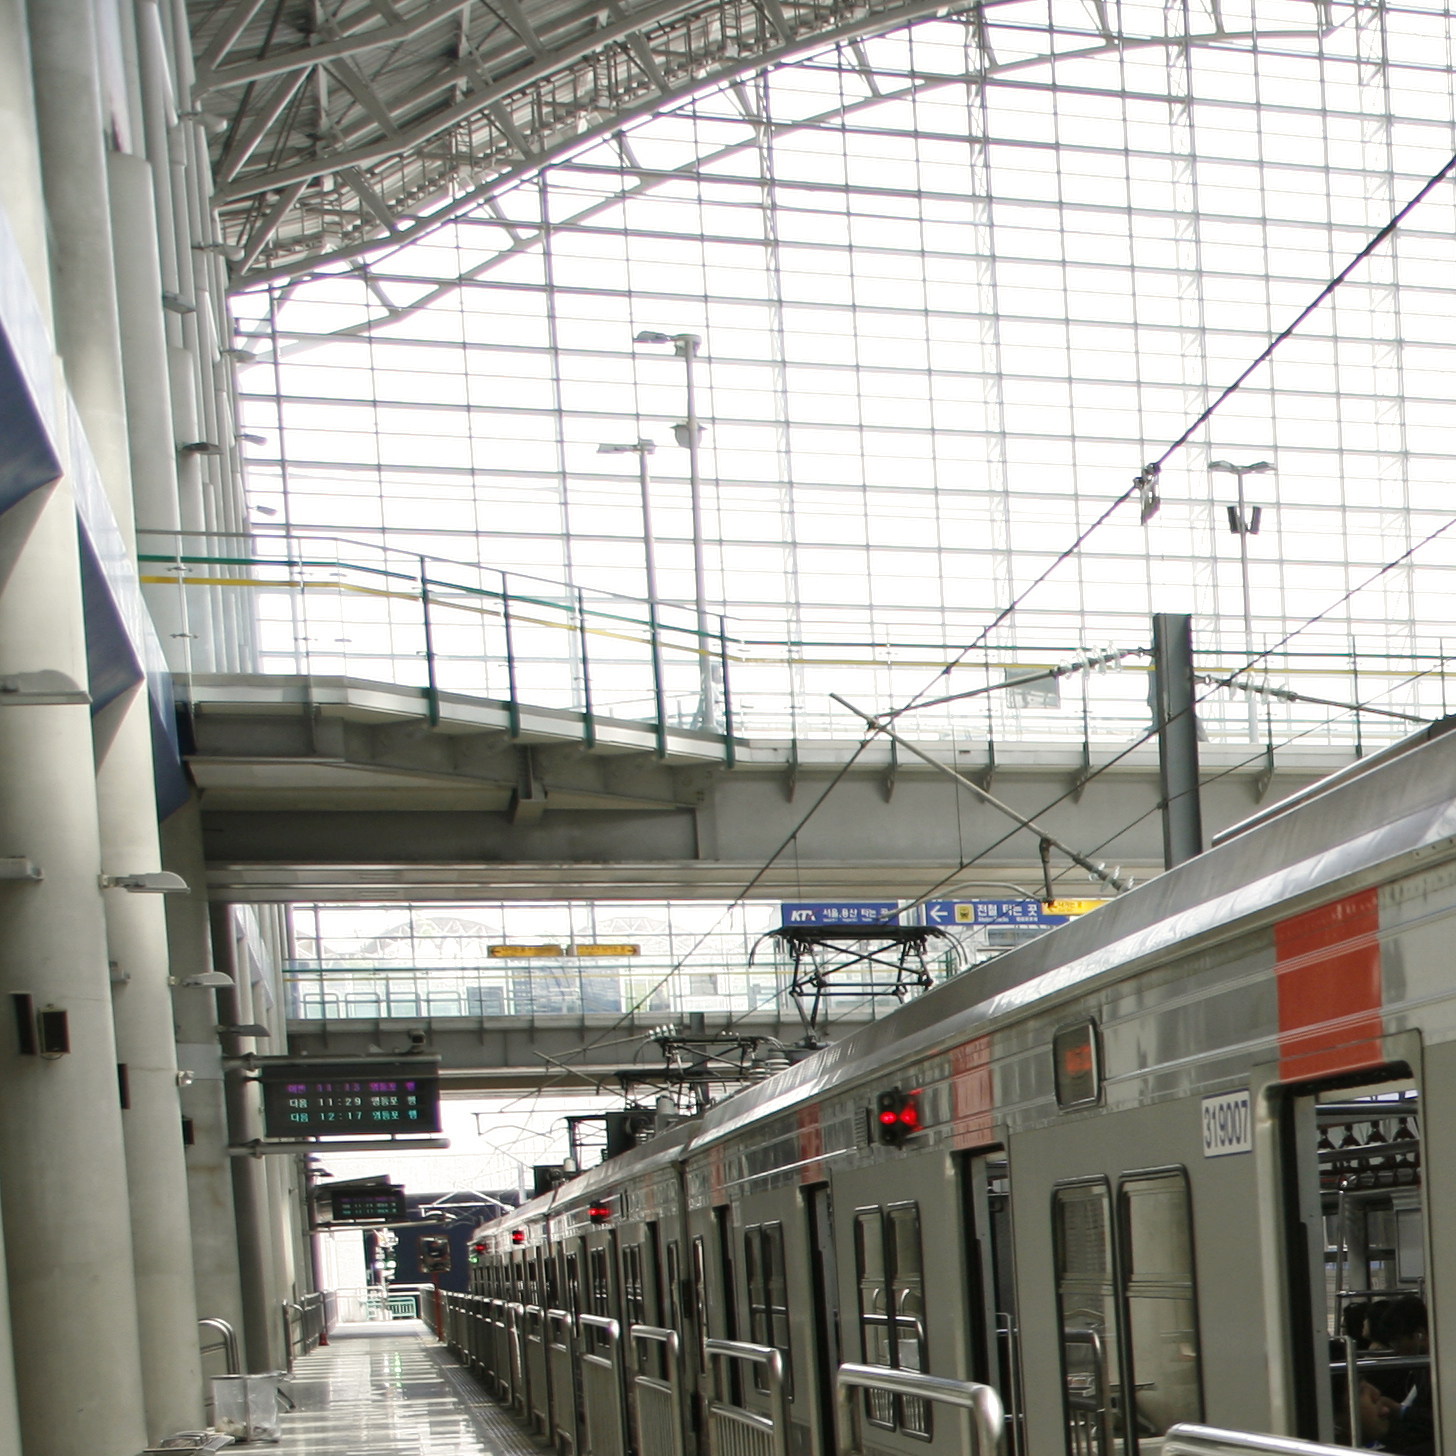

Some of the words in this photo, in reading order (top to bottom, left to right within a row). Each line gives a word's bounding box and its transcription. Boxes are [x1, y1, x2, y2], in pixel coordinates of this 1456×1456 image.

[791, 909, 818, 922] KTX
[318, 1097, 362, 1106] 11:29
[320, 1112, 362, 1121] 12:17
[1204, 1099, 1248, 1150] 319007
